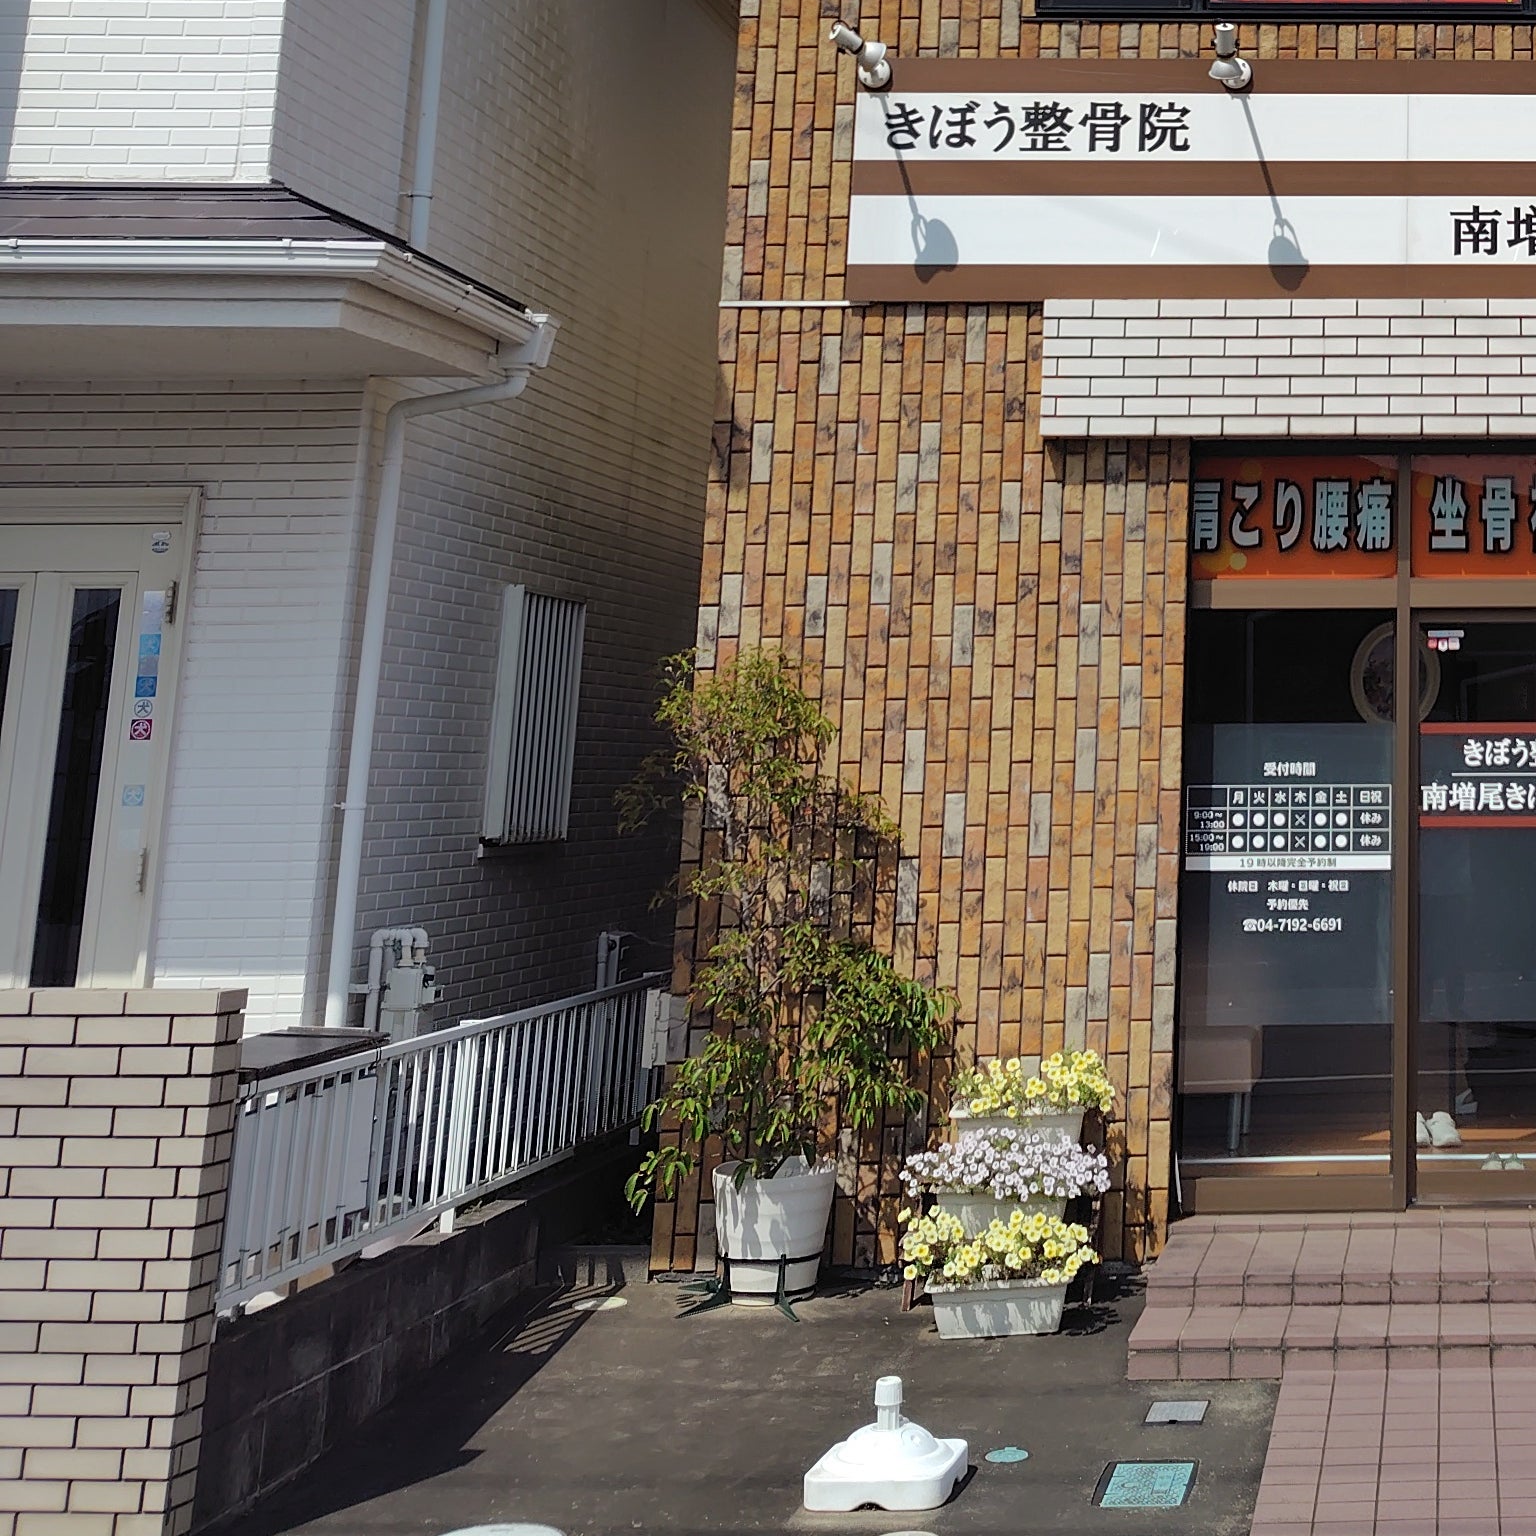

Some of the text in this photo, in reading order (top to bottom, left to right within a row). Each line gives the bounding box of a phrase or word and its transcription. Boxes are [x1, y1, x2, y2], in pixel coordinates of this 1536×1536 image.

[884, 102, 1191, 154] きぼう整骨院
[1194, 479, 1393, 551] 肩こり腰痛
[1263, 762, 1316, 776] 受付時間
[1232, 790, 1383, 805] 月 火 水 木 金 土 日祝
[1359, 812, 1382, 825] 休み
[1359, 834, 1382, 847] 休み
[1256, 917, 1343, 933] 04-7192-6691
